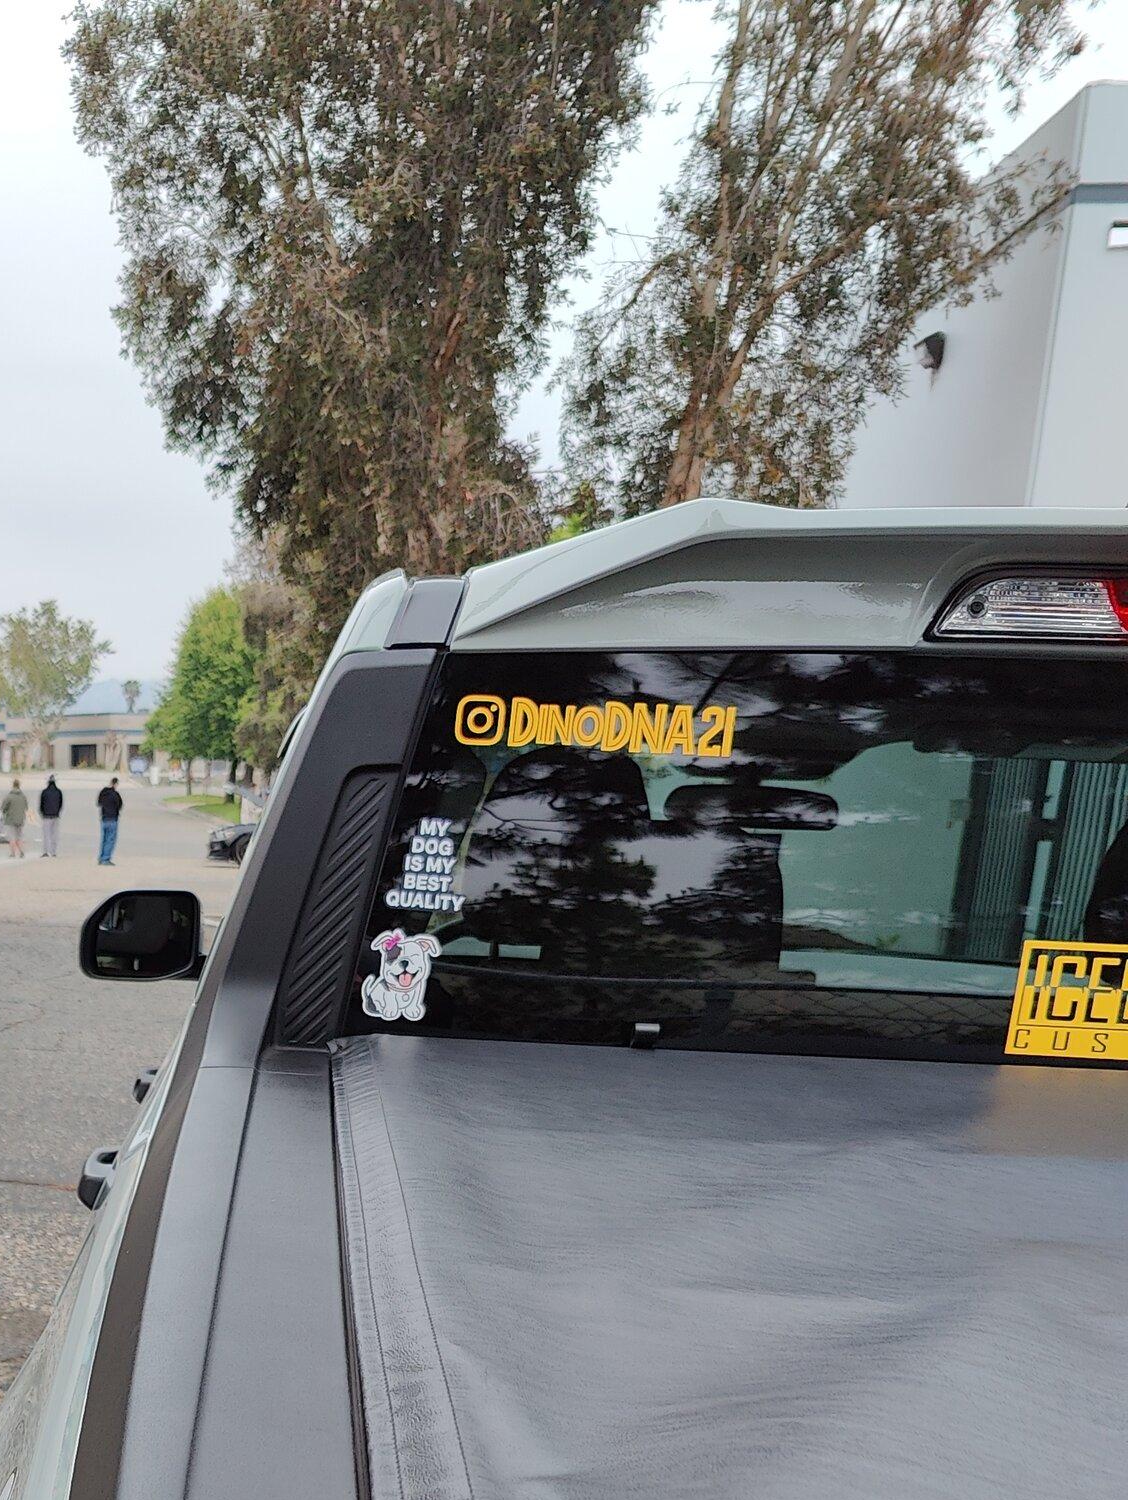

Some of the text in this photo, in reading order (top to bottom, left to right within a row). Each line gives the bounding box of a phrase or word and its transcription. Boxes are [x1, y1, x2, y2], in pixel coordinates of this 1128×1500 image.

[419, 817, 452, 837] MY
[412, 837, 454, 856] DOG
[404, 854, 458, 875] IS MY
[403, 873, 453, 893] BEST
[385, 889, 467, 912] QUALITY
